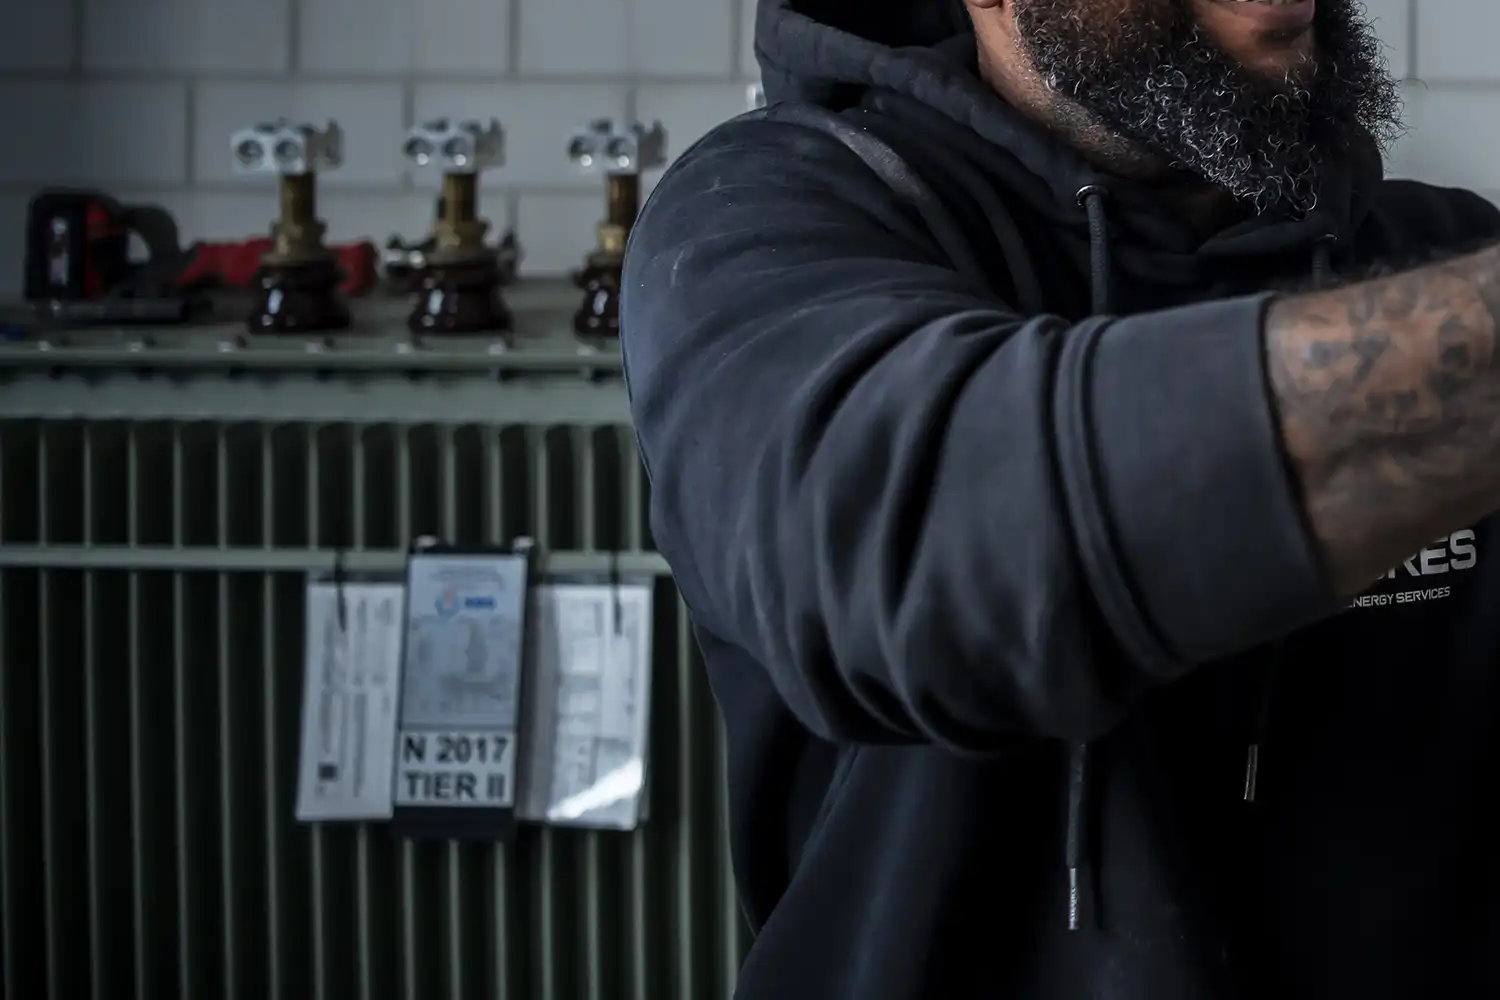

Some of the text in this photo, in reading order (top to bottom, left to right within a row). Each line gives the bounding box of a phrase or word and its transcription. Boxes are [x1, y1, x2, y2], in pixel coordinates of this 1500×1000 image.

[1348, 586, 1451, 608] NERGY SERVICES
[403, 736, 508, 765] N 2017
[404, 770, 477, 800] TIER
